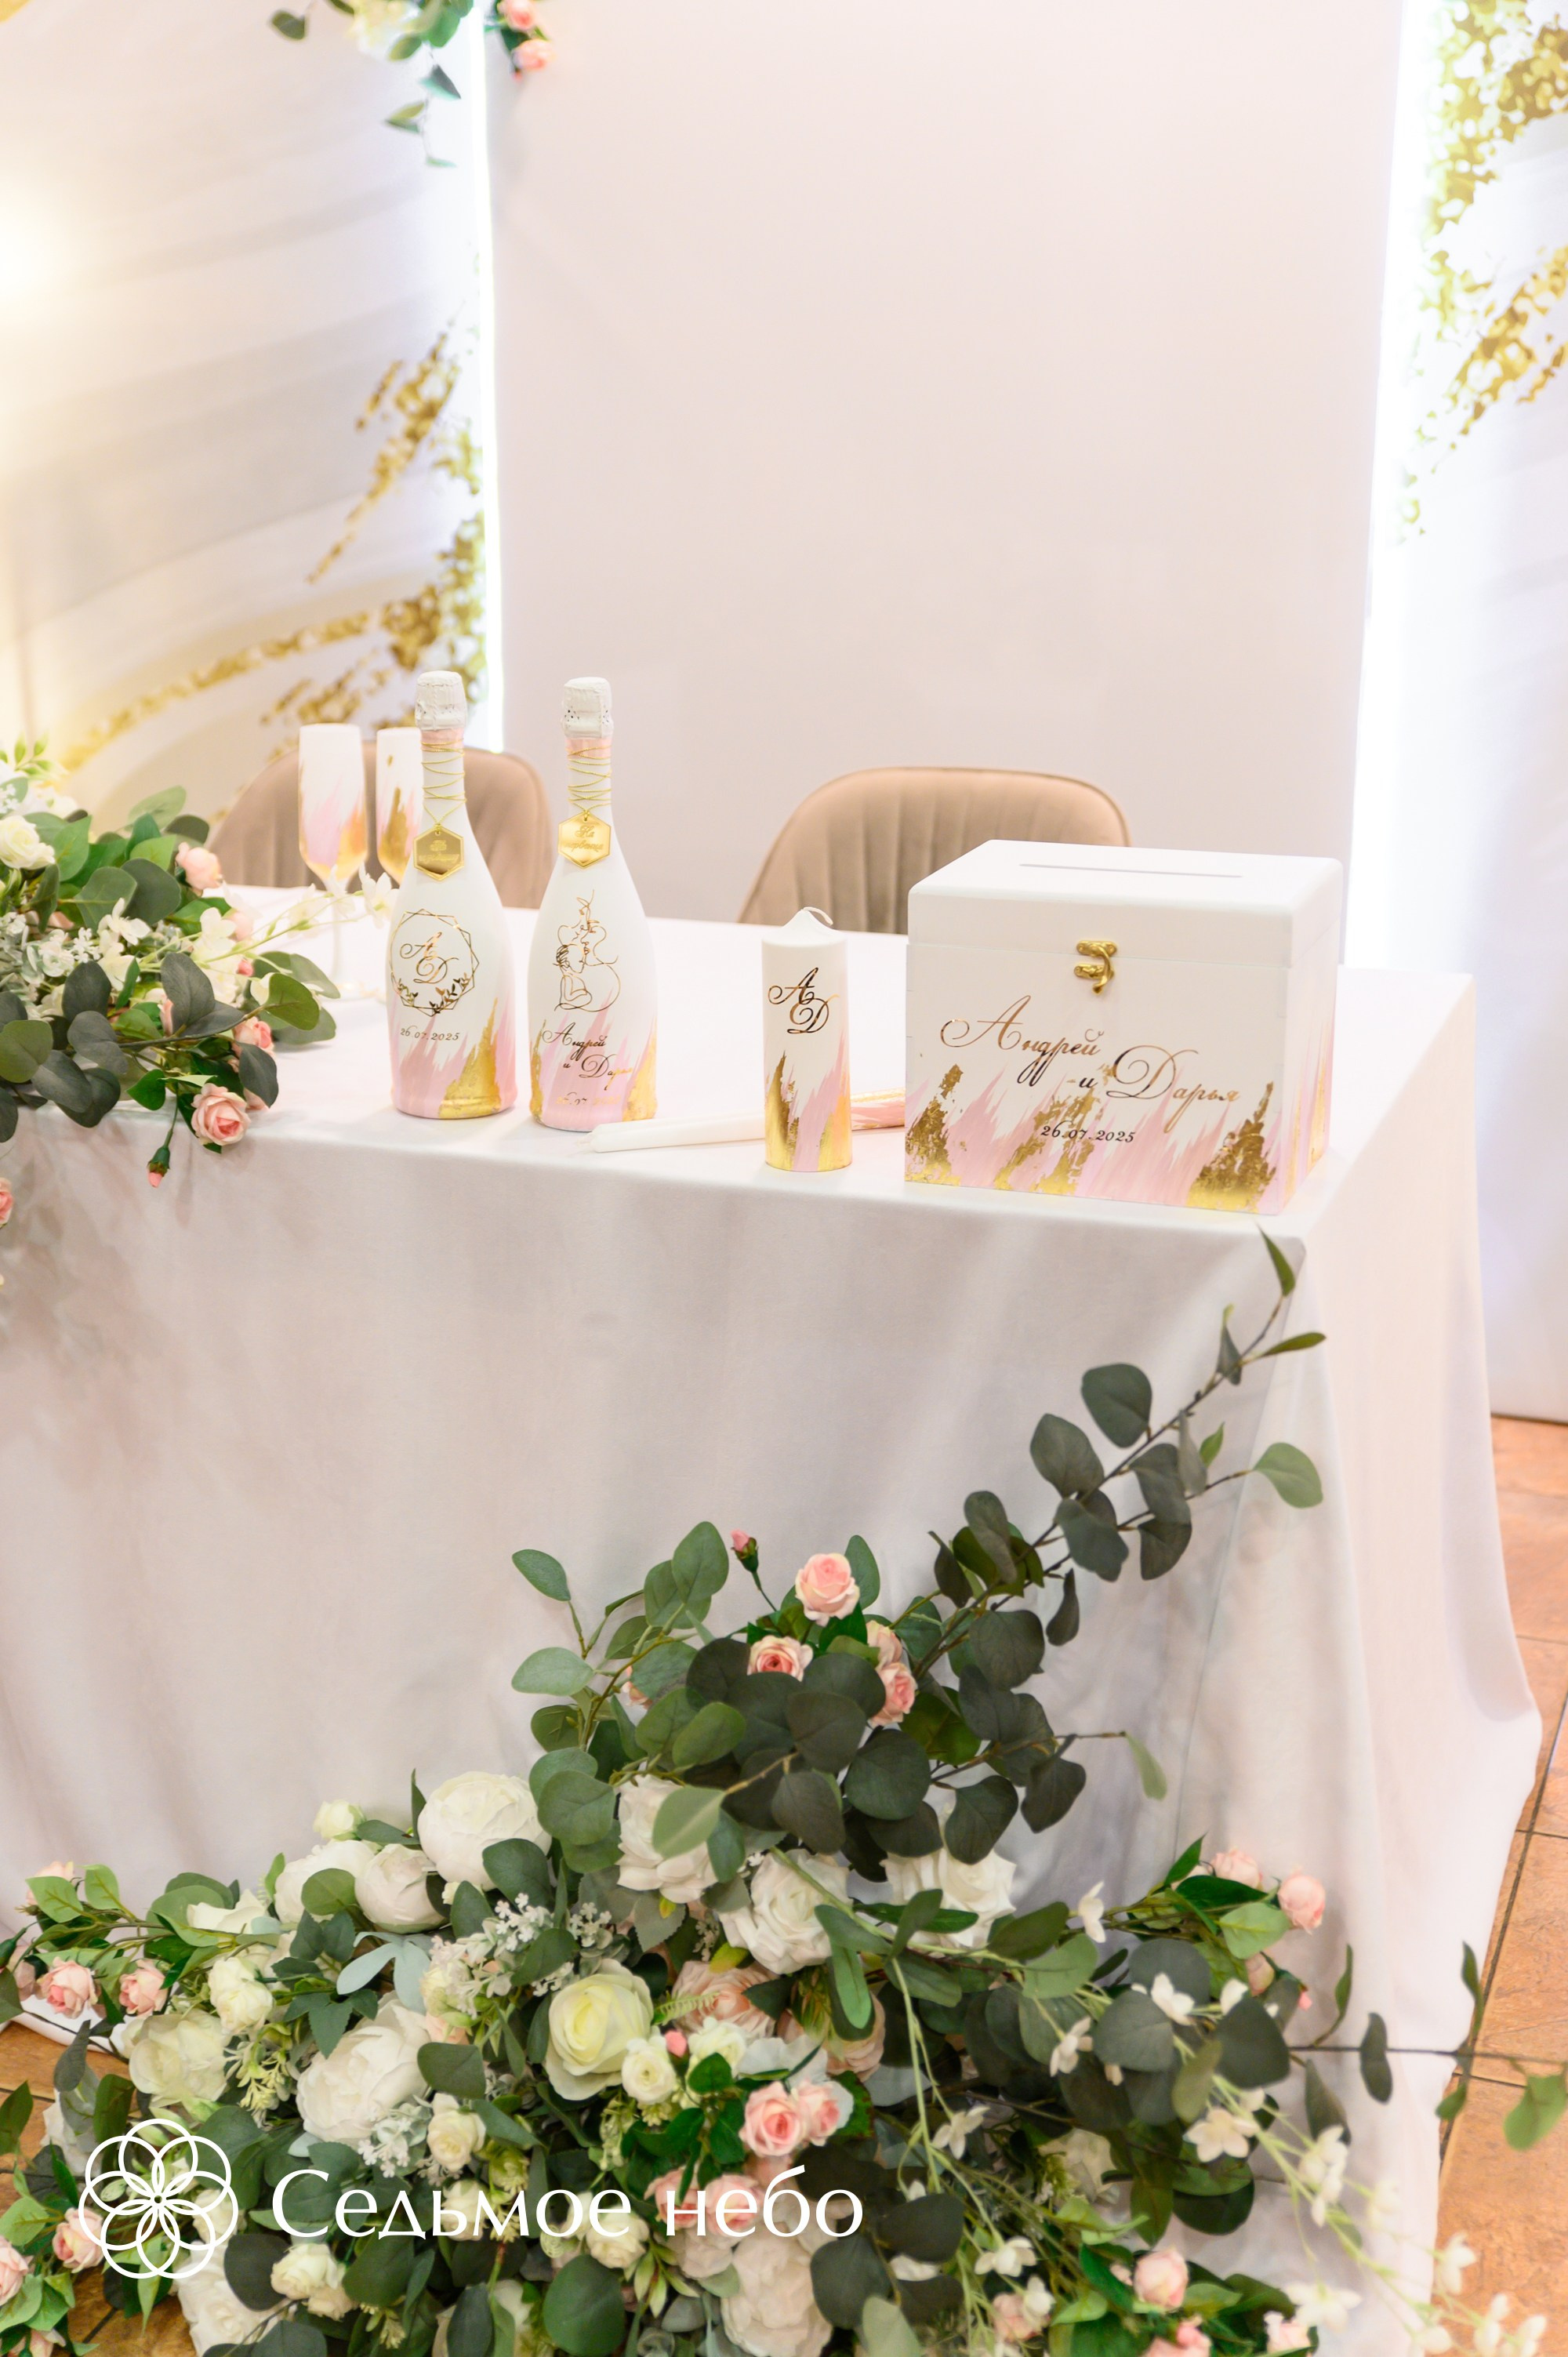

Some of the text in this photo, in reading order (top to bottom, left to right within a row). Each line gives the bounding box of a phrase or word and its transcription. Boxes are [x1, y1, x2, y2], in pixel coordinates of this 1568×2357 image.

[400, 1025, 460, 1041] 2607.2025
[542, 1022, 606, 1062] Андрей
[941, 995, 1104, 1087] Андрей
[1105, 1044, 1240, 1134] Дарья
[1040, 1120, 1136, 1143] 26.07.2025
